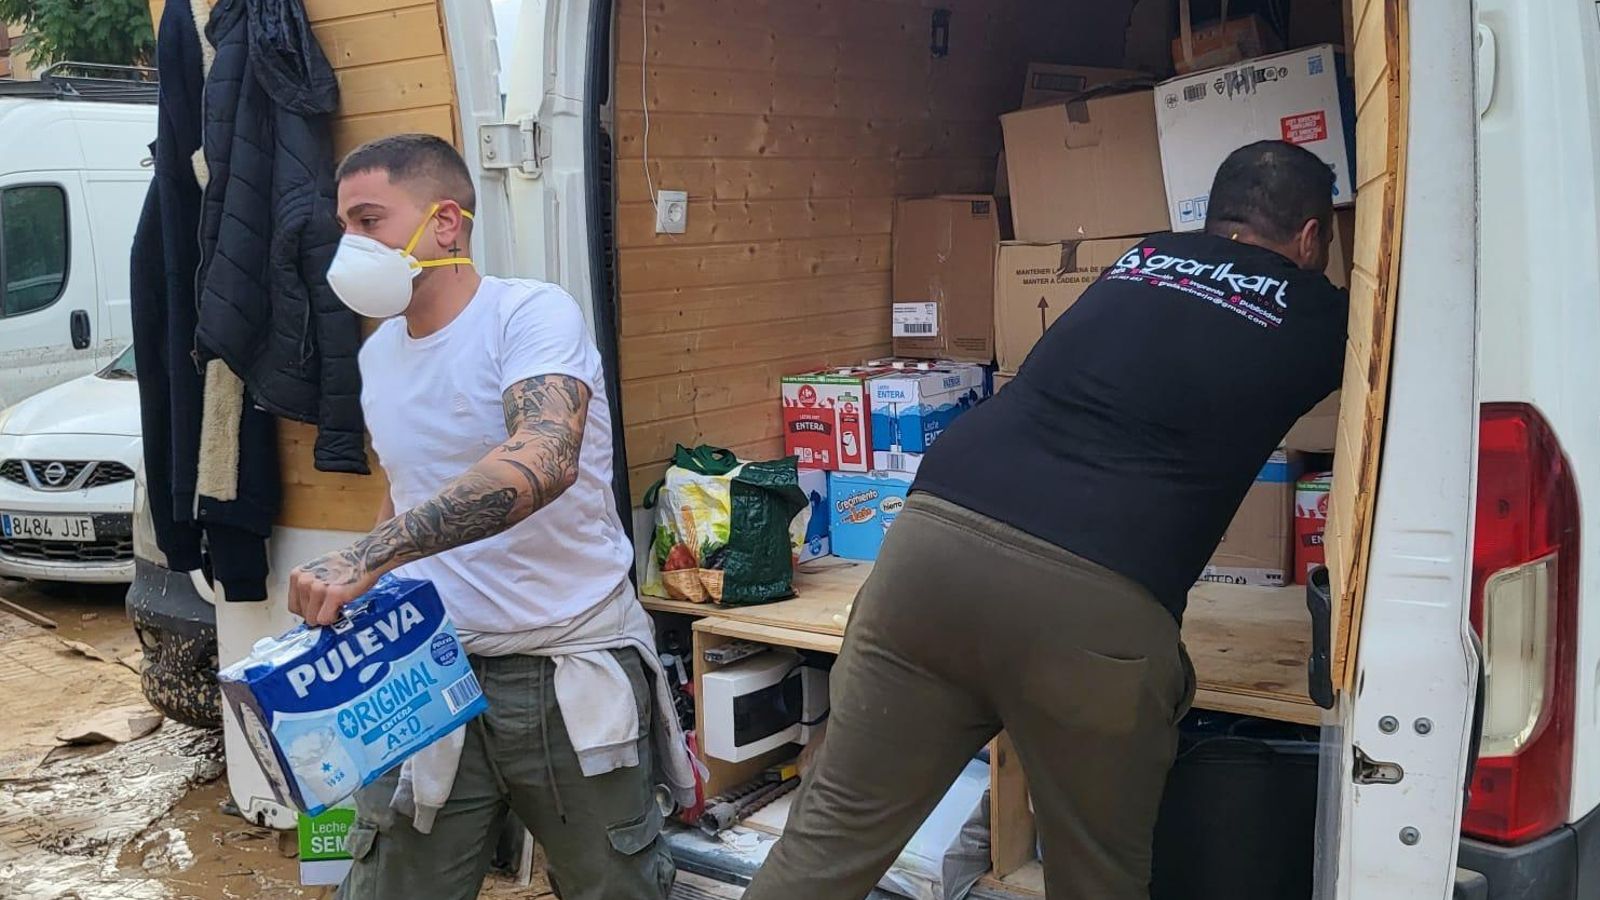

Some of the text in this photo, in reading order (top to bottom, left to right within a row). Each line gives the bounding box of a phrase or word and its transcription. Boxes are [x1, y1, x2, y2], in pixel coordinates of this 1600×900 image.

[1023, 277, 1049, 285] MANTER
[1057, 276, 1080, 284] CADEIA
[1239, 299, 1283, 324] publicidad
[877, 390, 905, 399] ENTERA
[795, 421, 825, 431] ENTERA
[836, 489, 878, 513] Crecimiento
[883, 501, 903, 511] hierro
[13, 517, 89, 538] 8484 JJF
[286, 601, 425, 698] PULEVA
[336, 661, 438, 739] ORIGINAL
[387, 715, 421, 750] A+D
[312, 821, 347, 834] Leche
